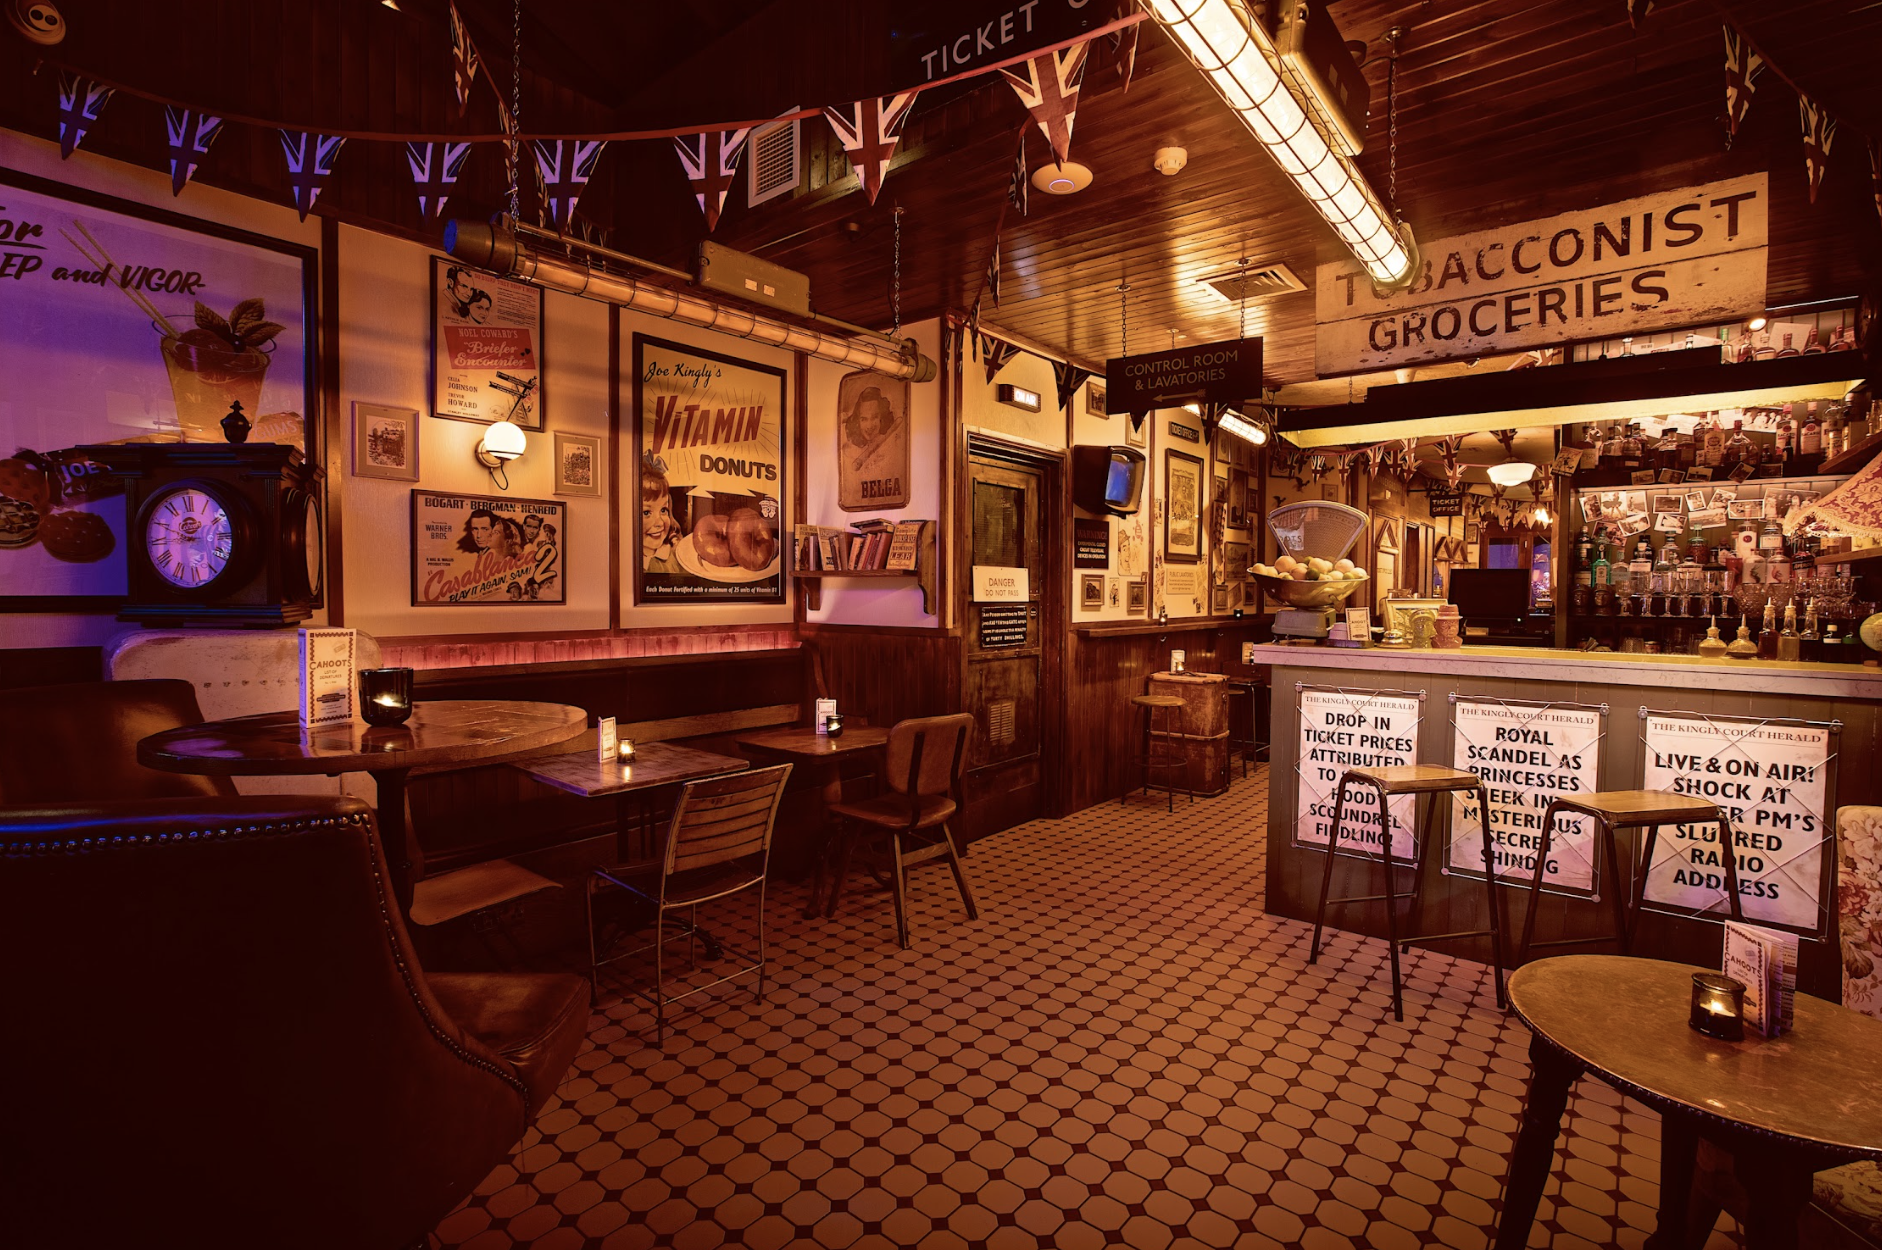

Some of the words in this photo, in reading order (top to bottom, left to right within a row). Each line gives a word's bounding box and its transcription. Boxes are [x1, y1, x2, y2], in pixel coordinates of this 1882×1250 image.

[920, 0, 1040, 80] TICKET
[0, 205, 44, 242] or
[1335, 190, 1757, 306] TBACCONIST
[51, 263, 114, 287] and
[1368, 269, 1669, 353] GROCERIES
[458, 328, 479, 338] NOEL
[480, 328, 518, 339] COWARD'S
[454, 351, 528, 367] Encounter
[1125, 357, 1190, 377] CONTROL
[1193, 349, 1239, 368] ROOM
[643, 361, 670, 383] Joe
[673, 362, 723, 389] Kingly's
[1135, 379, 1144, 391] &
[1147, 367, 1226, 390] LAVATORIES
[448, 382, 478, 393] JOHNSON
[1015, 390, 1026, 403] ON
[1026, 393, 1037, 407] AIR
[447, 398, 478, 410] HOWARD
[699, 453, 777, 482] DONUTS
[861, 477, 902, 499] BELGA
[425, 497, 465, 510] BOGART
[470, 500, 516, 513] BERGMAN
[521, 504, 557, 515] HENREID
[1433, 505, 1459, 513] OFFICE
[425, 524, 452, 533] WARNER
[534, 542, 558, 584] 2
[448, 588, 471, 602] PLAY
[471, 585, 478, 596] IT
[509, 566, 532, 581] SAM!
[646, 585, 657, 593] Each
[658, 585, 673, 593] Donut
[673, 585, 693, 594] Fortified
[693, 585, 704, 593] with
[708, 585, 727, 593] minimum
[728, 585, 734, 594] of
[734, 585, 740, 593] 25
[740, 585, 750, 593] units
[750, 585, 756, 594] of
[985, 589, 994, 597] DO
[988, 577, 1016, 588] DANGER
[309, 659, 352, 670] CAHOOTS
[1322, 697, 1350, 706] KINGLY
[1351, 699, 1378, 708] COURT
[1380, 702, 1415, 711] HERALD
[1325, 712, 1367, 728] DROP
[1374, 716, 1390, 731] IN
[1460, 707, 1480, 716] THE
[1481, 709, 1515, 719] KINGLY
[1516, 712, 1550, 721] COURT
[1552, 714, 1594, 725] HERALD
[1304, 729, 1355, 747] TICKET
[1360, 734, 1413, 753] PRICES
[1495, 726, 1554, 746] ROYAL
[1652, 722, 1676, 732] THE
[1678, 724, 1721, 736] KINGLY
[1722, 727, 1765, 738] COURT
[1767, 731, 1821, 743] HERALD
[1309, 748, 1405, 768] ATTRIBUTED
[1467, 745, 1551, 768] SCANDEL
[1559, 754, 1582, 770] AS
[1655, 752, 1701, 772] LIVE
[1705, 757, 1721, 774] &
[1725, 759, 1759, 778] ON
[1766, 763, 1815, 783] AIR!
[1317, 767, 1336, 782] TO
[1468, 765, 1580, 792] PRINCESSES
[1673, 776, 1752, 801] SHOCK
[1761, 786, 1791, 805] AT
[1755, 809, 1816, 832] PM'S
[1480, 849, 1559, 874] SHINDG
[1724, 951, 1762, 978] CAHOOTS
